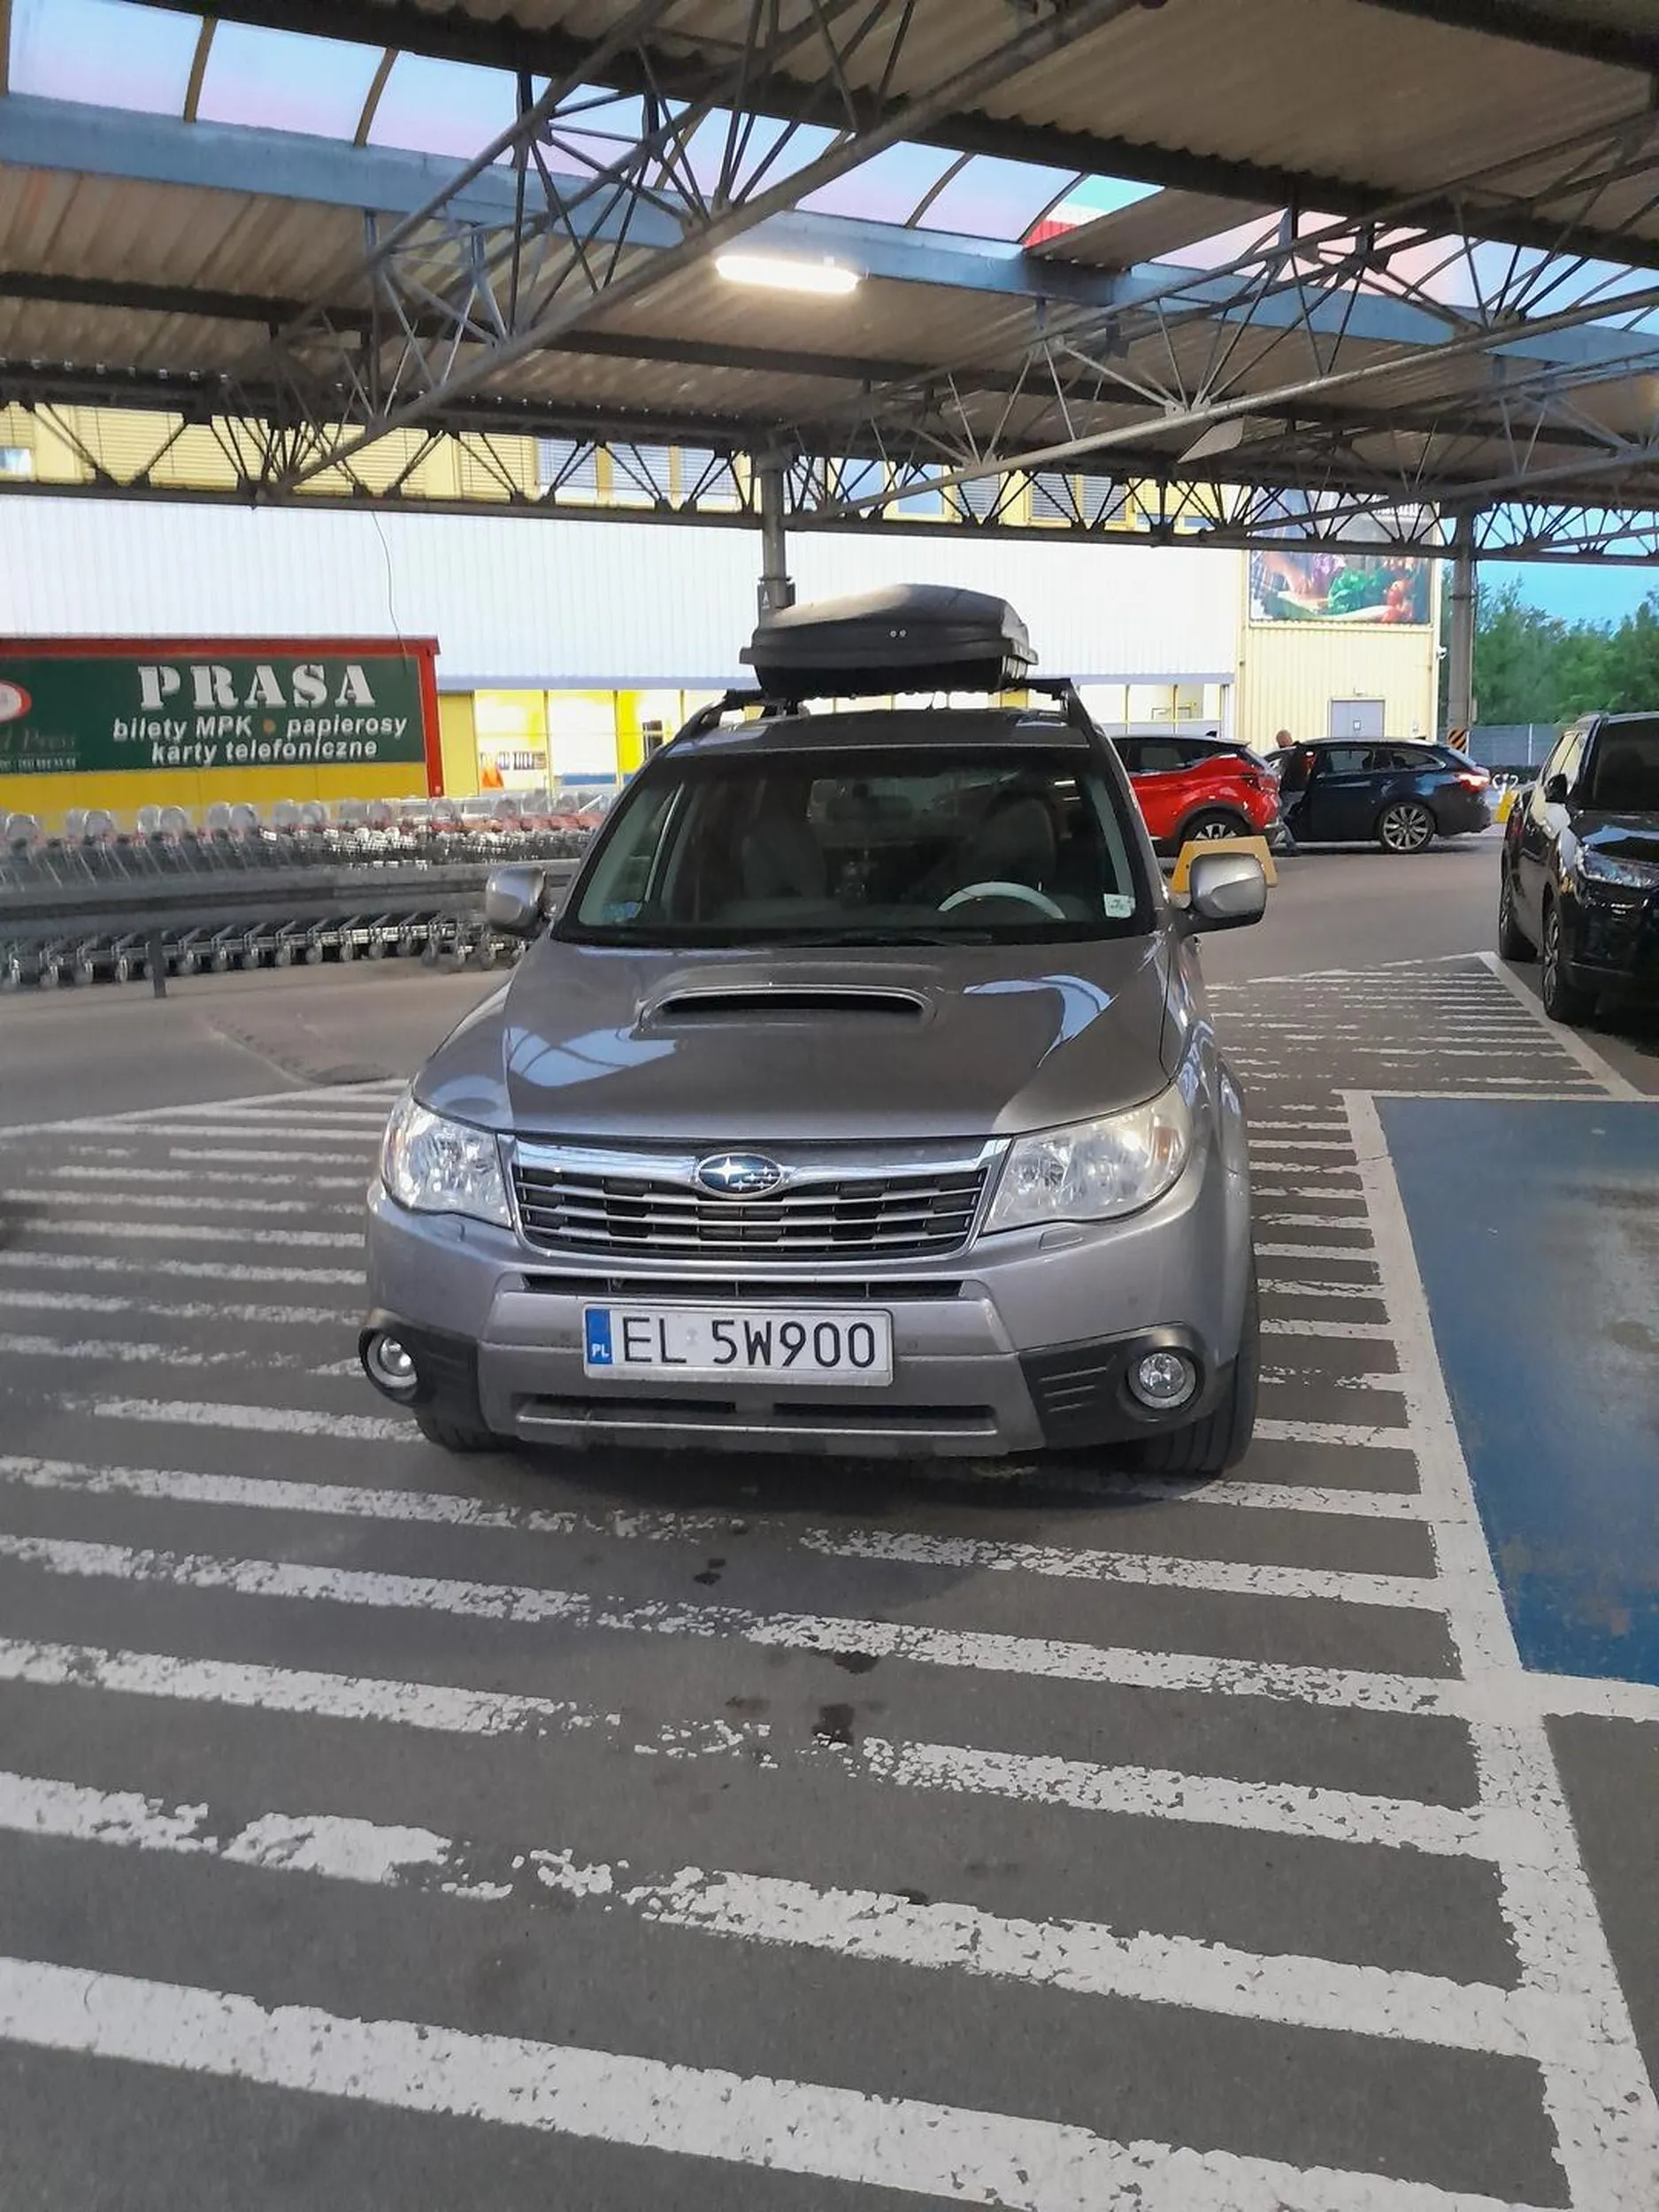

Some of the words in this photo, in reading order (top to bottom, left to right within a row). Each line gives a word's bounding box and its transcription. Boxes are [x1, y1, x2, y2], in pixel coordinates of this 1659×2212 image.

[137, 664, 376, 710] PRASA
[113, 717, 188, 742] bilety
[196, 715, 252, 739] MPK
[287, 713, 407, 740] papierosy
[151, 741, 218, 766] karty
[226, 738, 377, 764] telefoniczne
[591, 1343, 610, 1358] PL
[622, 1316, 687, 1363] EL
[711, 1318, 875, 1368] 5W900
